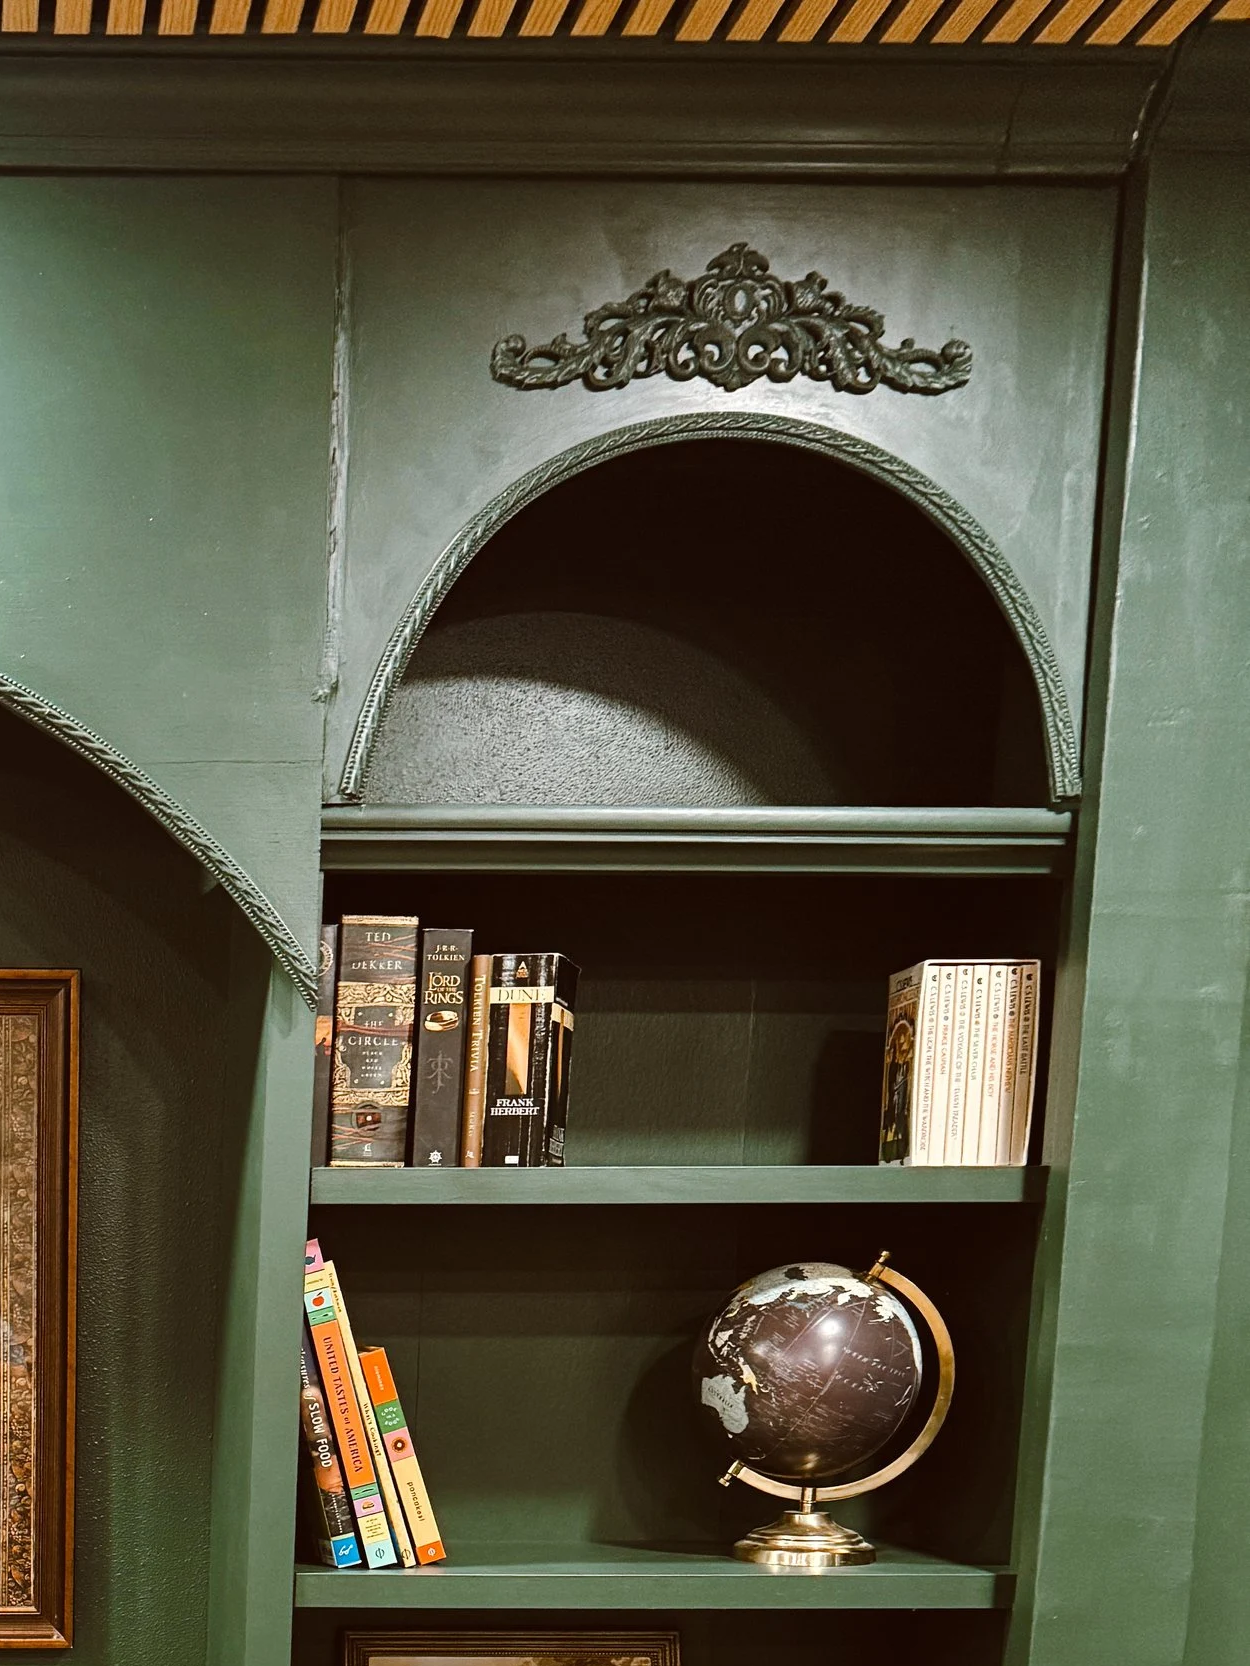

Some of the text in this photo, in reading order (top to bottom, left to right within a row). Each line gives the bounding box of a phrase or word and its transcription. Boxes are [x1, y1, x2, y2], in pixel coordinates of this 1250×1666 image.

[351, 960, 403, 970] DEKKER
[428, 971, 461, 991] LORD
[424, 990, 464, 1005] RINGS
[470, 974, 487, 1073] TOLKIEN TRIVIA
[347, 1036, 399, 1046] CIRCLE
[490, 1106, 540, 1116] HERBERT
[496, 1097, 534, 1107] FRANK
[322, 1336, 339, 1375] UNITED
[332, 1375, 350, 1416] TASTES
[343, 1423, 363, 1473] AMERICA
[308, 1402, 325, 1435] SLOW
[316, 1437, 333, 1468] FOOD
[406, 1481, 426, 1522] pancakes!
